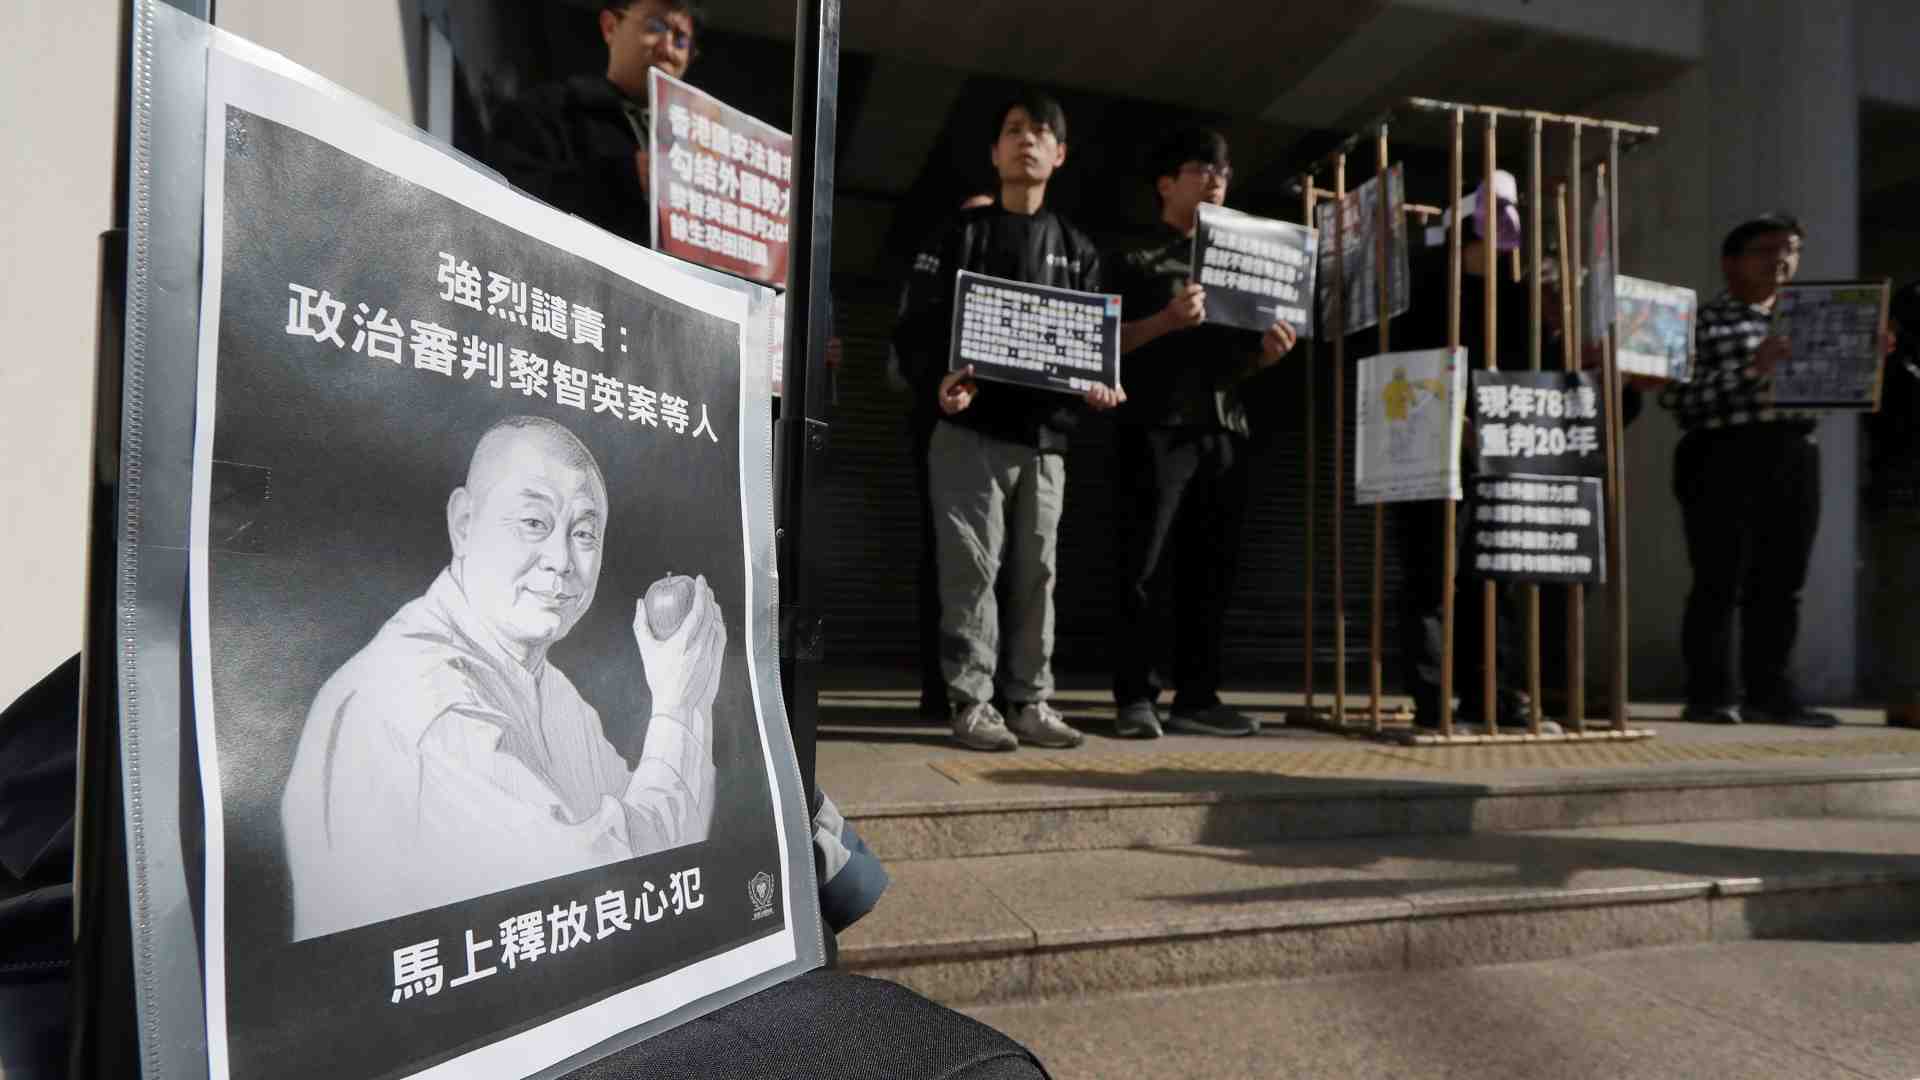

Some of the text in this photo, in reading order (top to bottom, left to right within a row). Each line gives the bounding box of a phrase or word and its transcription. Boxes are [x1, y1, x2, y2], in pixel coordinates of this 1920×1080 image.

[437, 251, 629, 353] 強烈譴責：
[284, 282, 719, 443] 政治審判黎智英案等人
[1477, 385, 1596, 419] 現年78歲
[1480, 423, 1598, 458] 重判20年
[391, 866, 705, 1004] 馬上釋放良心犯
